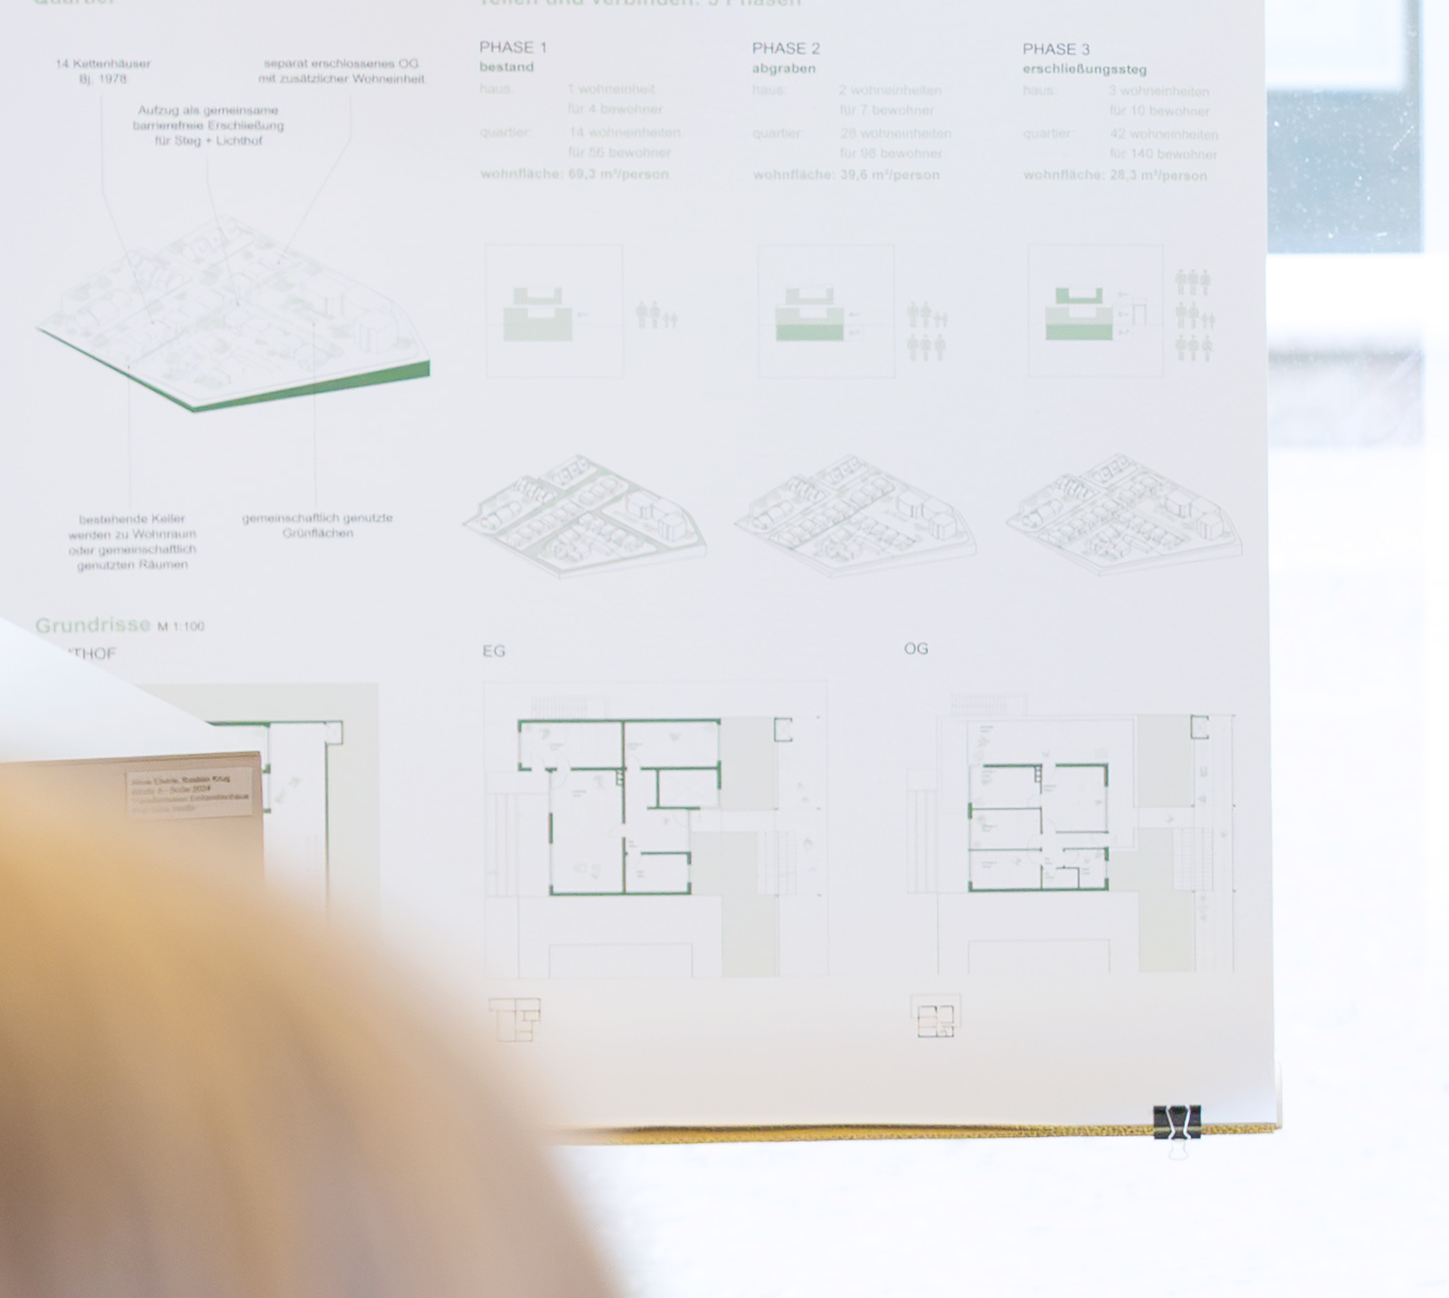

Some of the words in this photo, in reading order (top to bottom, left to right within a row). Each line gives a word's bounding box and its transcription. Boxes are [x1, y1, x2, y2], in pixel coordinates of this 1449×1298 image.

[478, 40, 532, 53] PHASE
[751, 41, 805, 55] PHASE
[811, 41, 820, 55] 2
[1022, 42, 1076, 55] PHASE
[1082, 43, 1090, 56] 3
[478, 60, 534, 72] bestand
[751, 62, 816, 75] abgraben
[1022, 62, 1147, 77] erschließungssteg
[35, 616, 151, 634] Grundrisse
[157, 620, 168, 632] M
[173, 620, 205, 632] 1:100
[481, 643, 505, 657] EG
[903, 641, 929, 655] OG
